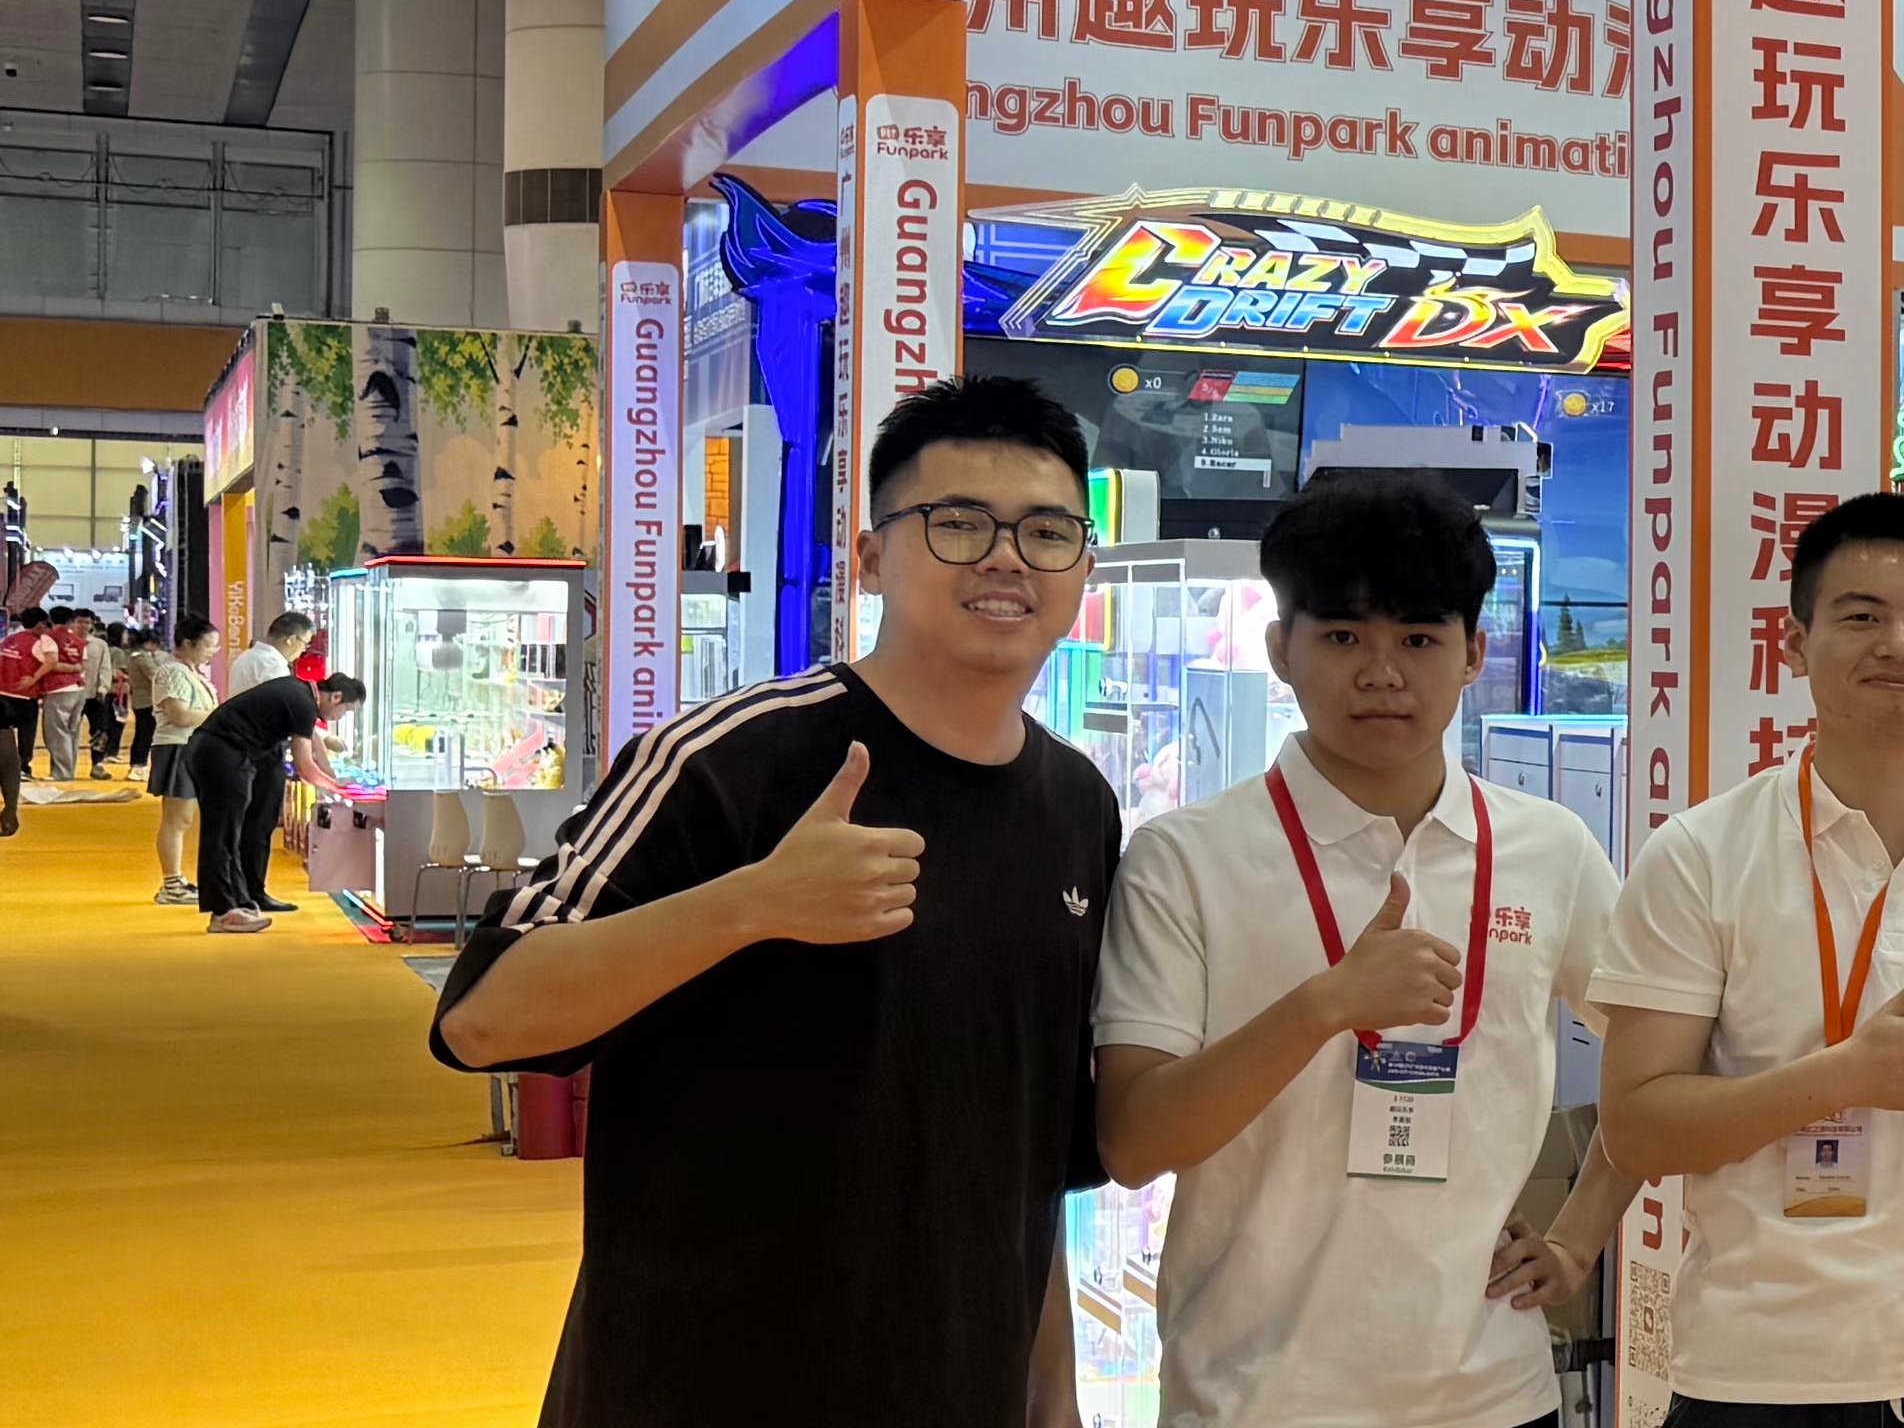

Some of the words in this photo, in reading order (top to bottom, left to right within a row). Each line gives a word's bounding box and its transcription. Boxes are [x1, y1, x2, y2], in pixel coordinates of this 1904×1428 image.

[876, 141, 949, 161] Funpark
[967, 77, 1175, 139] ngzhou
[1185, 92, 1419, 162] Funpark
[1426, 119, 1631, 179] animati
[882, 178, 939, 394] Guangzh
[1047, 220, 1389, 327] CRAZY
[1145, 285, 1397, 339] DRIFT
[626, 317, 666, 510] Guangzhou
[1643, 312, 1680, 718] Funpark
[625, 519, 664, 659] Funpark
[1489, 926, 1532, 945] npark
